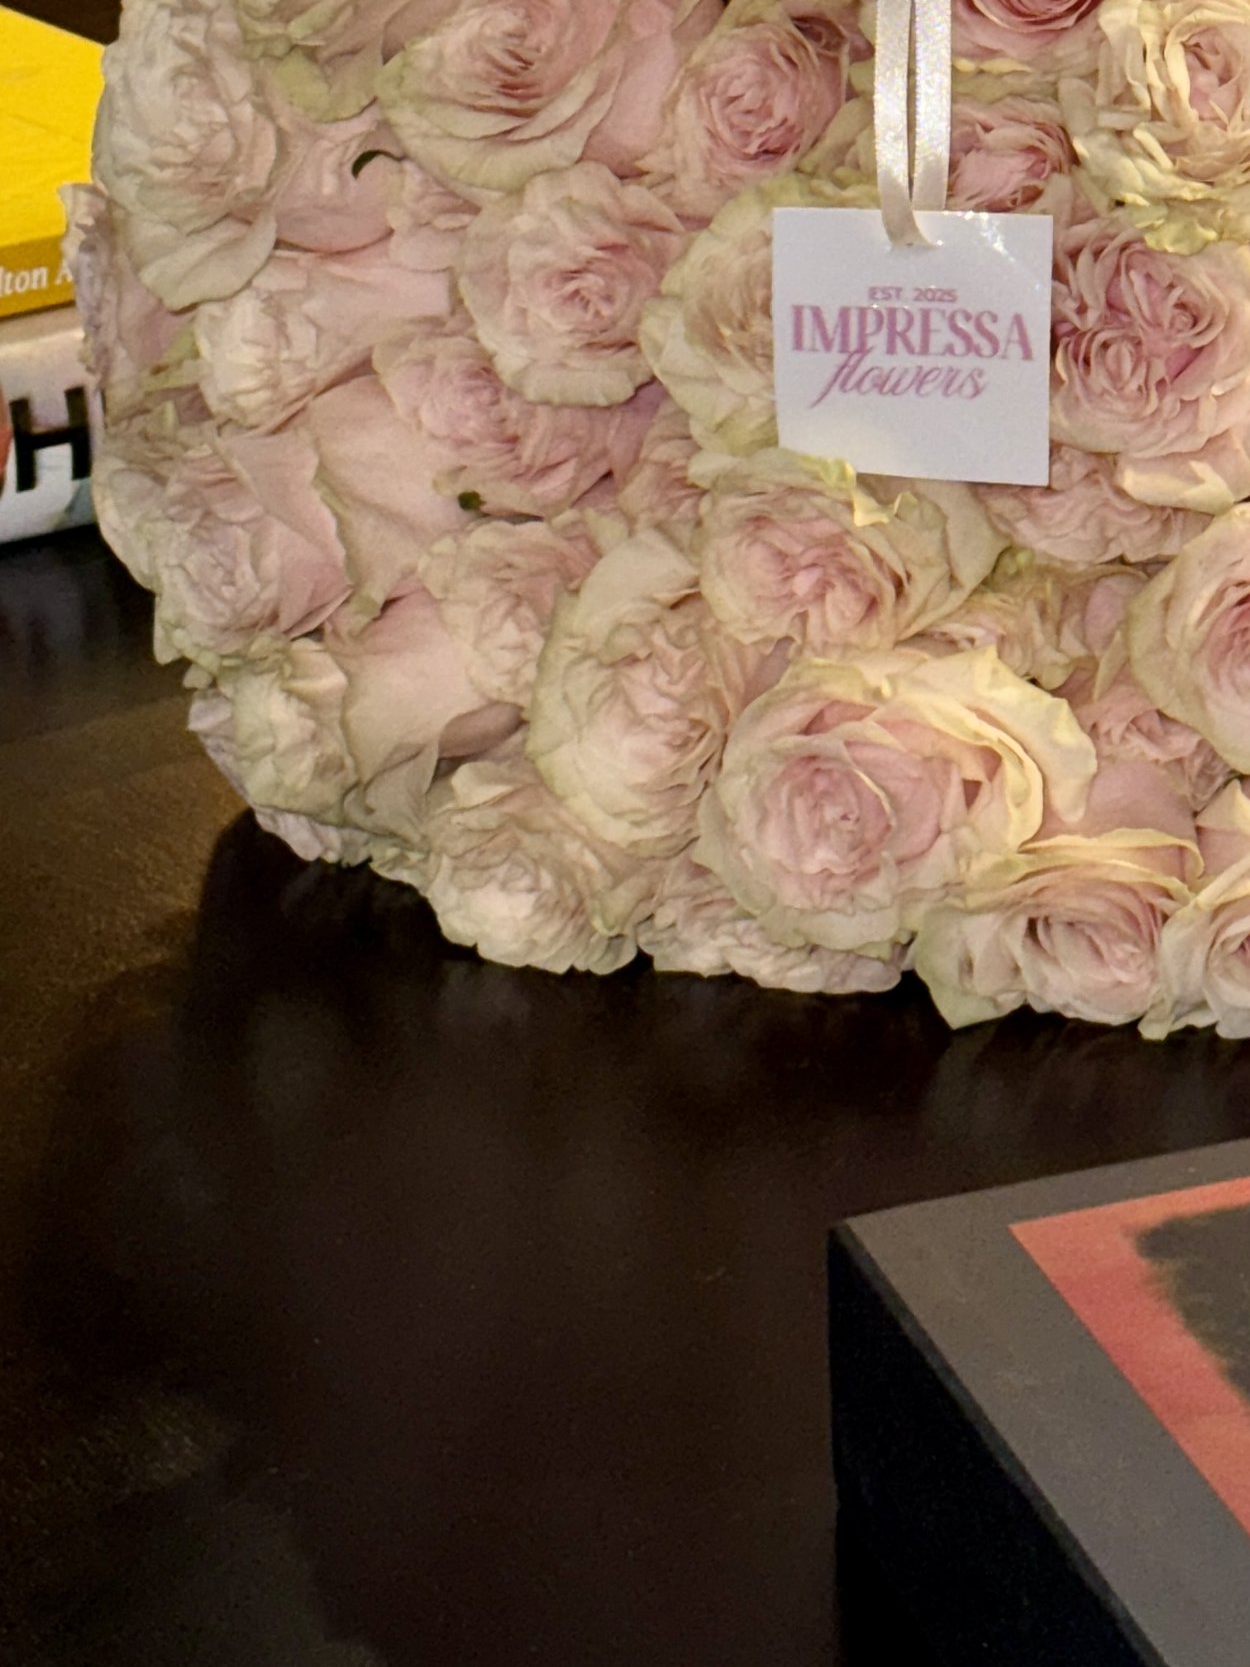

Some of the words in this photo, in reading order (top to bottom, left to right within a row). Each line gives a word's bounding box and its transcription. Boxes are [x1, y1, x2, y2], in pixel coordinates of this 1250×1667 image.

[913, 287, 957, 303] 2025
[791, 304, 1033, 361] IMPRESSA
[810, 347, 986, 409] flowers
